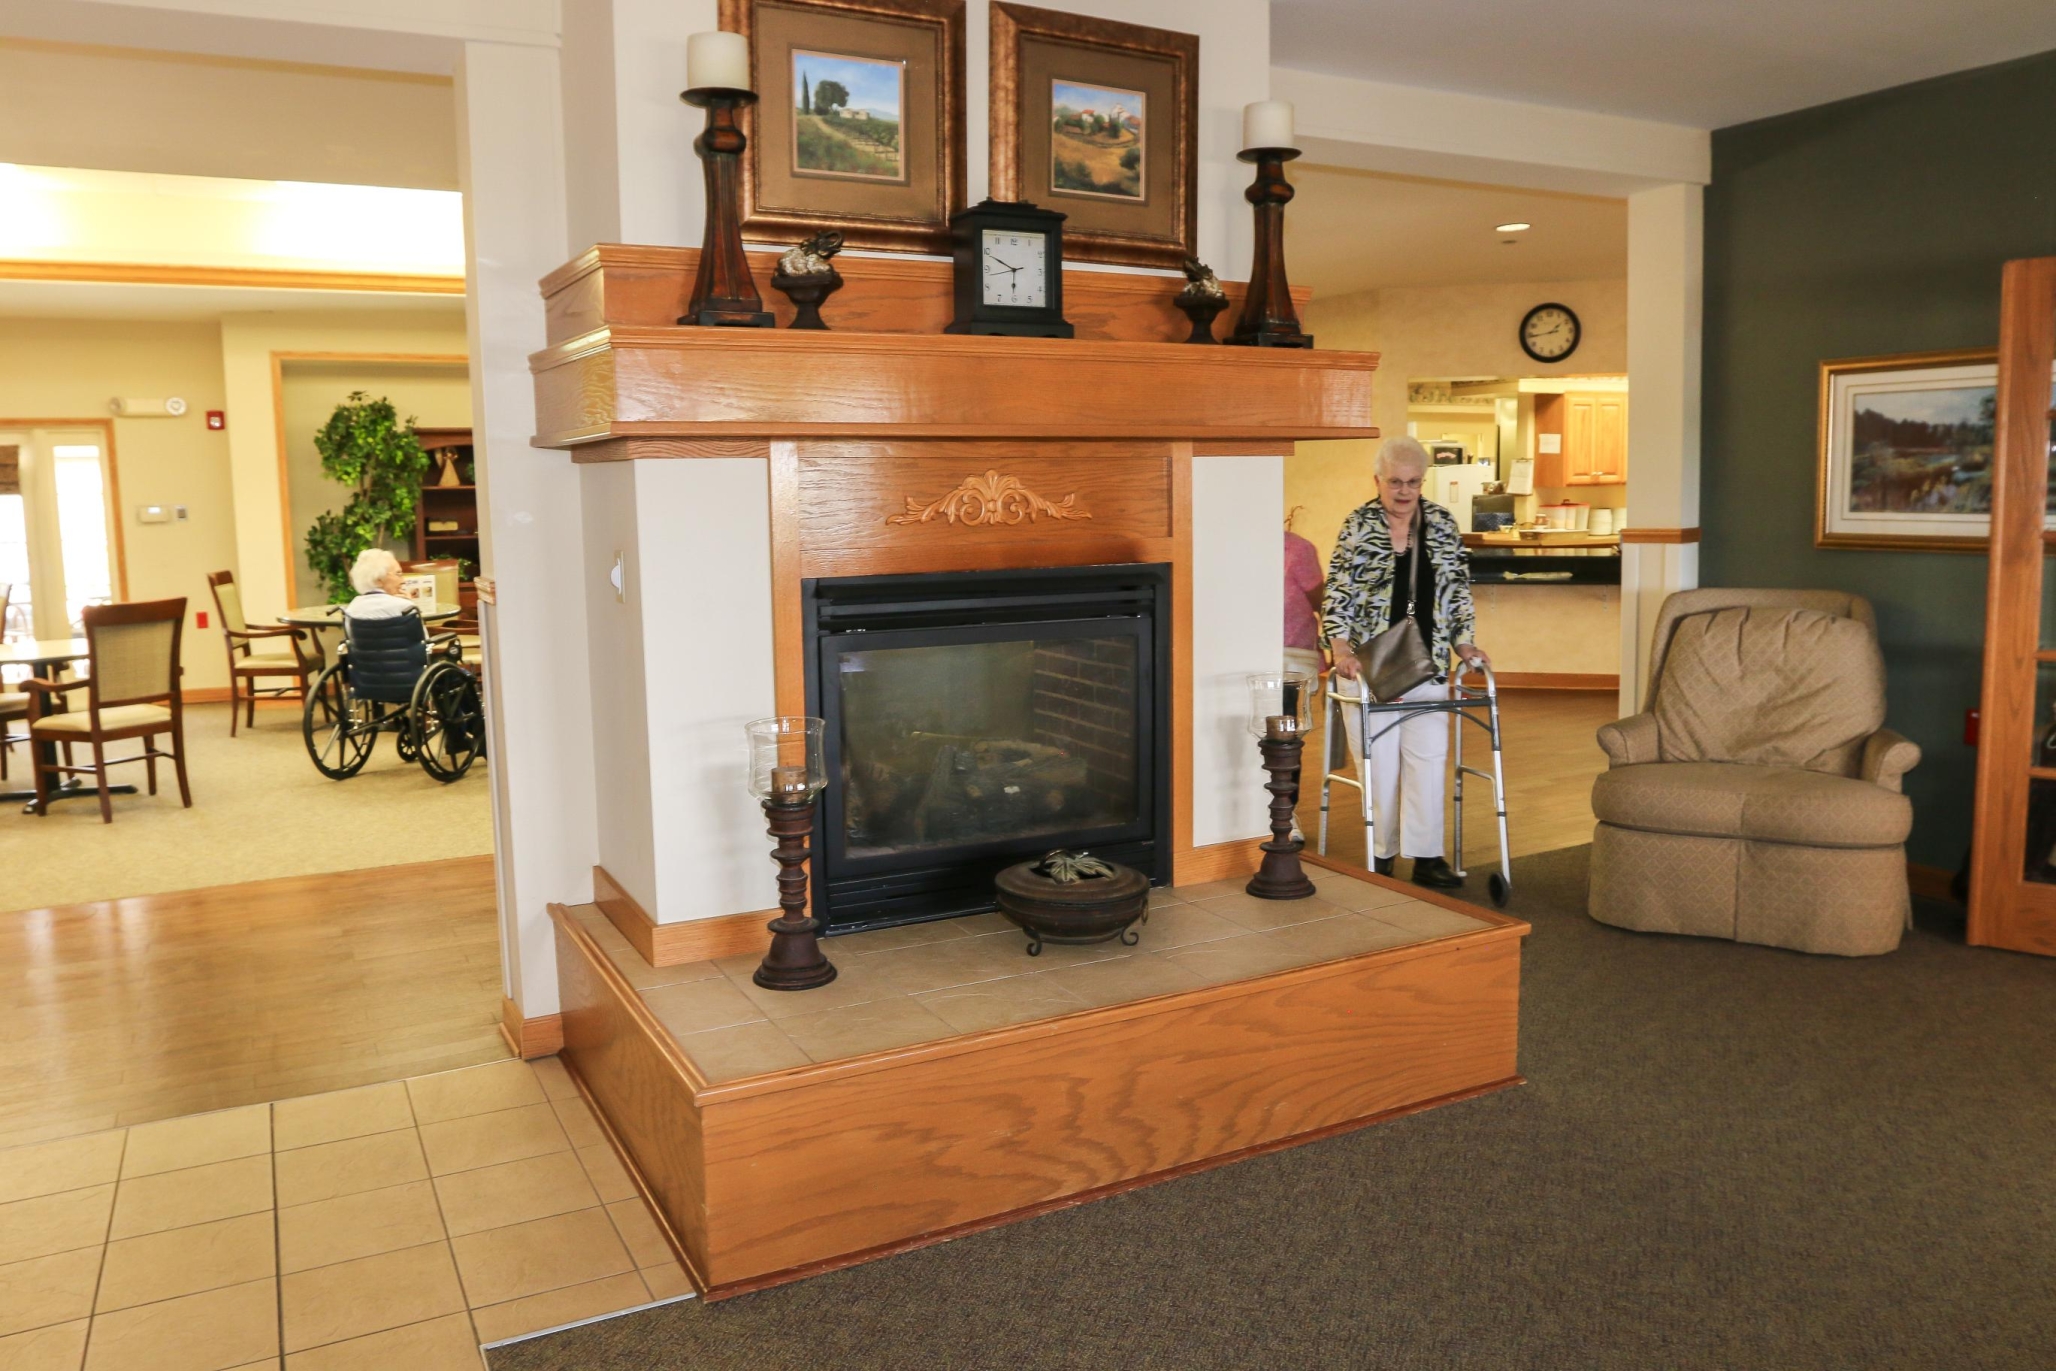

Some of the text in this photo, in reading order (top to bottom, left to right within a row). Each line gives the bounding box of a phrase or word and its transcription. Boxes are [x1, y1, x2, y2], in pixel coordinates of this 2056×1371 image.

[984, 247, 990, 255] 10
[984, 265, 990, 273] 9
[1037, 268, 1042, 276] 3
[997, 294, 1002, 302] 7
[1027, 295, 1033, 303] 5
